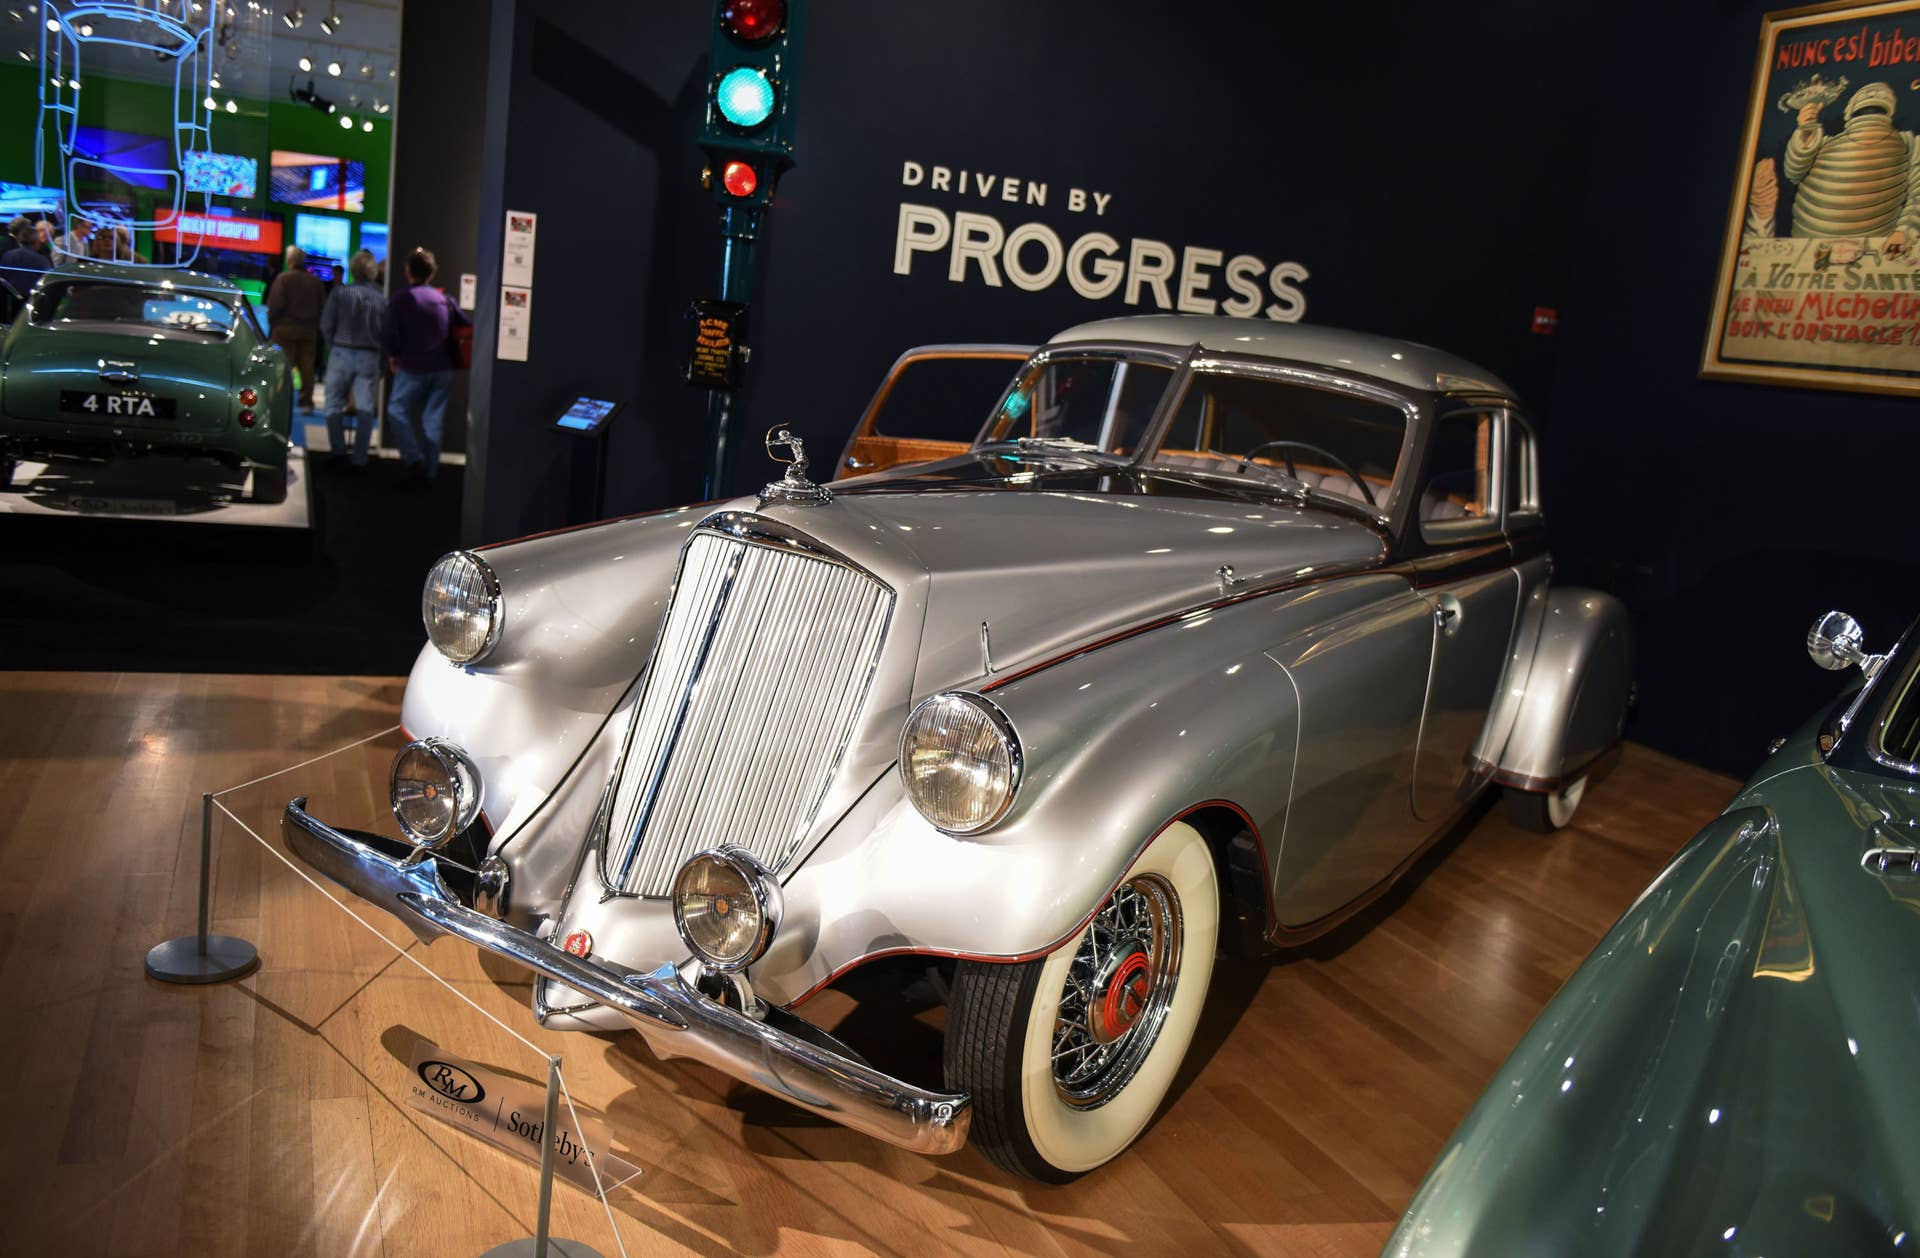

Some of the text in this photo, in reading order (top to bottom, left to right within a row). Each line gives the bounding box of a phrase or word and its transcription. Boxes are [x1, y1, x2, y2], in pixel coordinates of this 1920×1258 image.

[1776, 37, 1832, 71] NUNC
[903, 161, 1111, 216] DRIVEN BY
[894, 203, 1310, 324] PROGRESS
[1765, 263, 1838, 290] VOTRE
[83, 394, 155, 416] 4 RTA
[432, 1065, 468, 1098] RM
[412, 1086, 481, 1122] RM AUCTIONS
[507, 1111, 595, 1168] Sotby's
